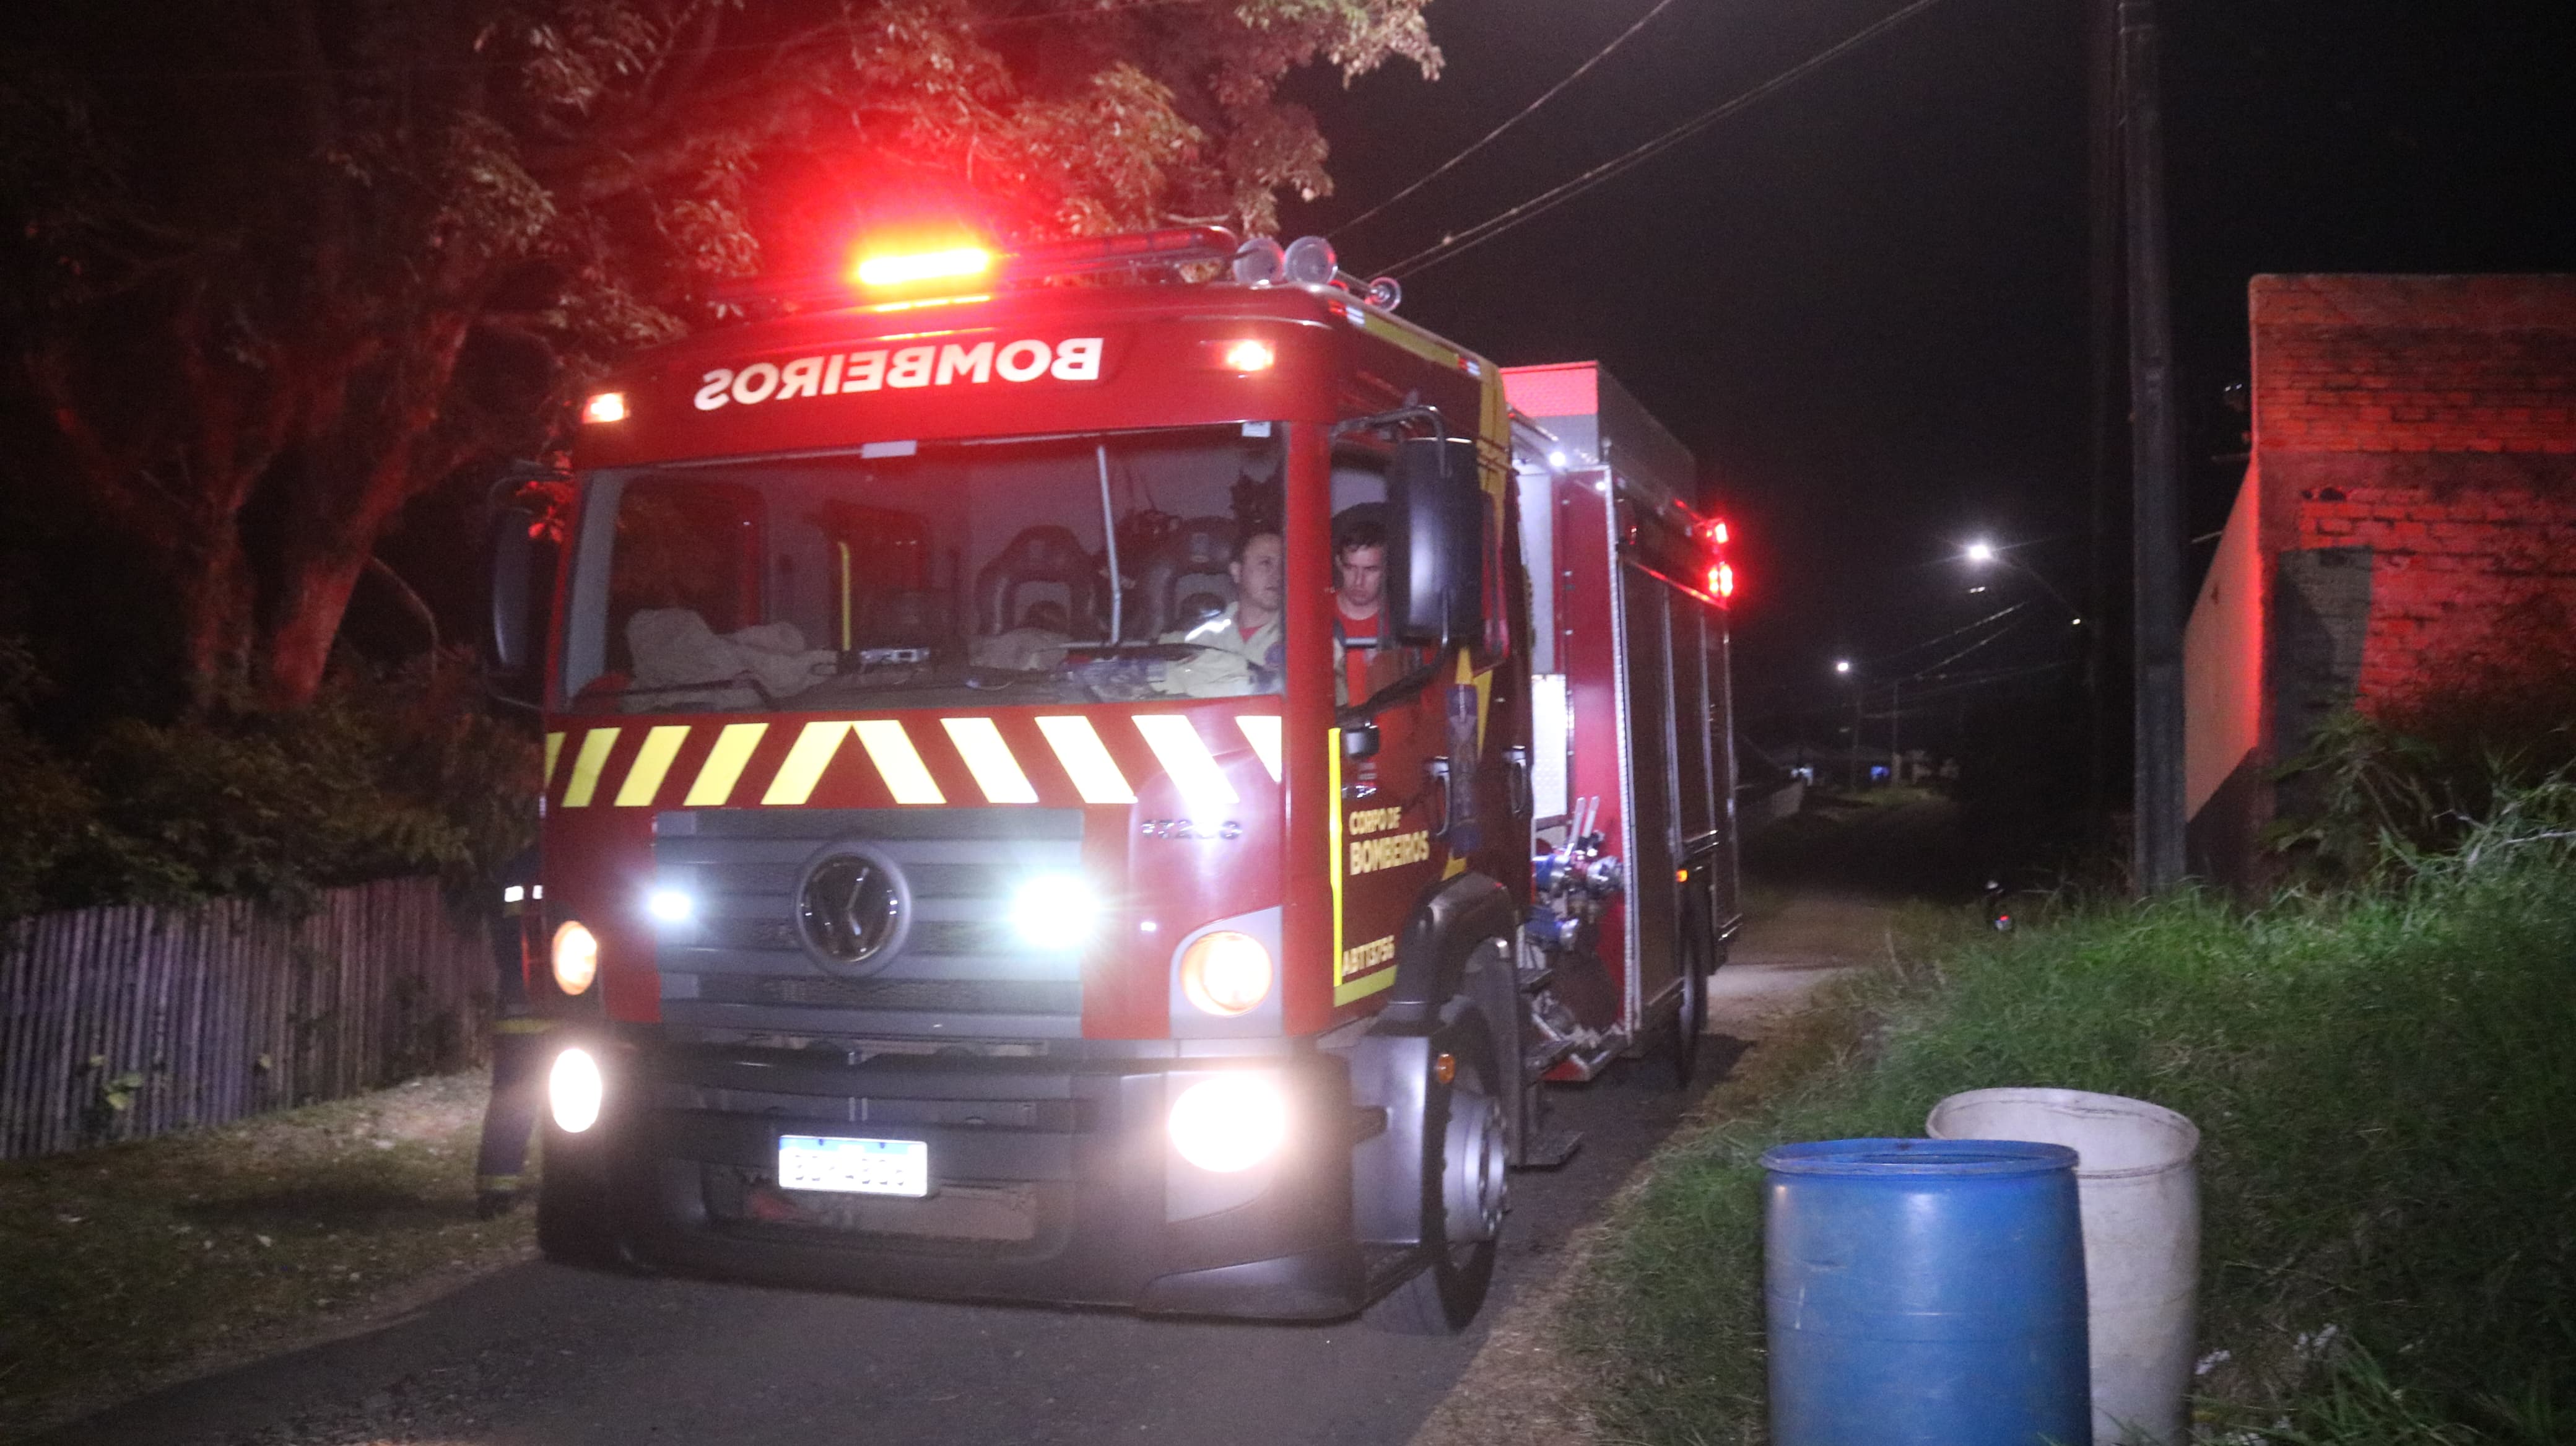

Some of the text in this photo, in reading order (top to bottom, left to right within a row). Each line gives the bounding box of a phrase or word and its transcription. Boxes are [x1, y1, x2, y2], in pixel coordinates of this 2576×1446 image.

[1349, 806, 1401, 835] CORPO DE
[1350, 830, 1430, 875] BOMBEIROS
